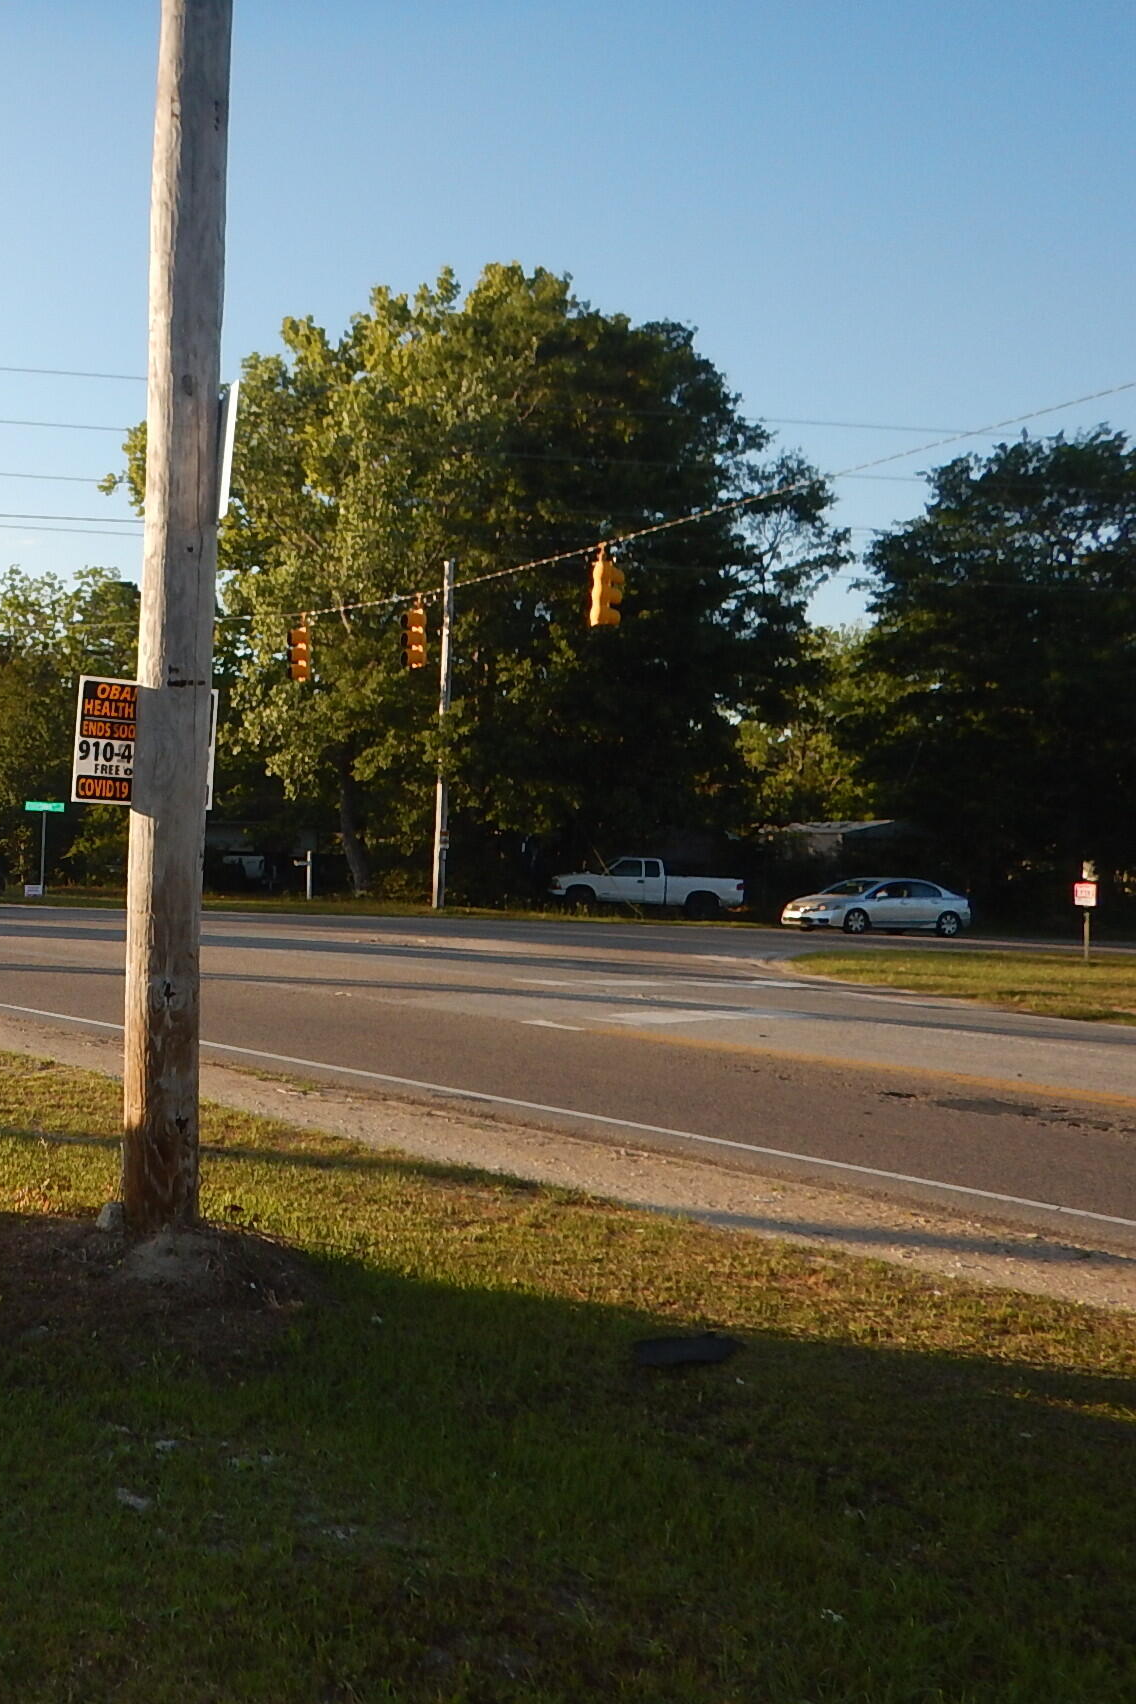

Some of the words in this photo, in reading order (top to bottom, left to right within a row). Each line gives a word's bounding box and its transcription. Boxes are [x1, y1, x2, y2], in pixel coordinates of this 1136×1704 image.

[98, 684, 138, 701] OBA
[84, 699, 133, 718] HEALTH
[82, 721, 111, 737] ENDS
[79, 740, 133, 763] 910-4
[95, 764, 120, 775] FREE
